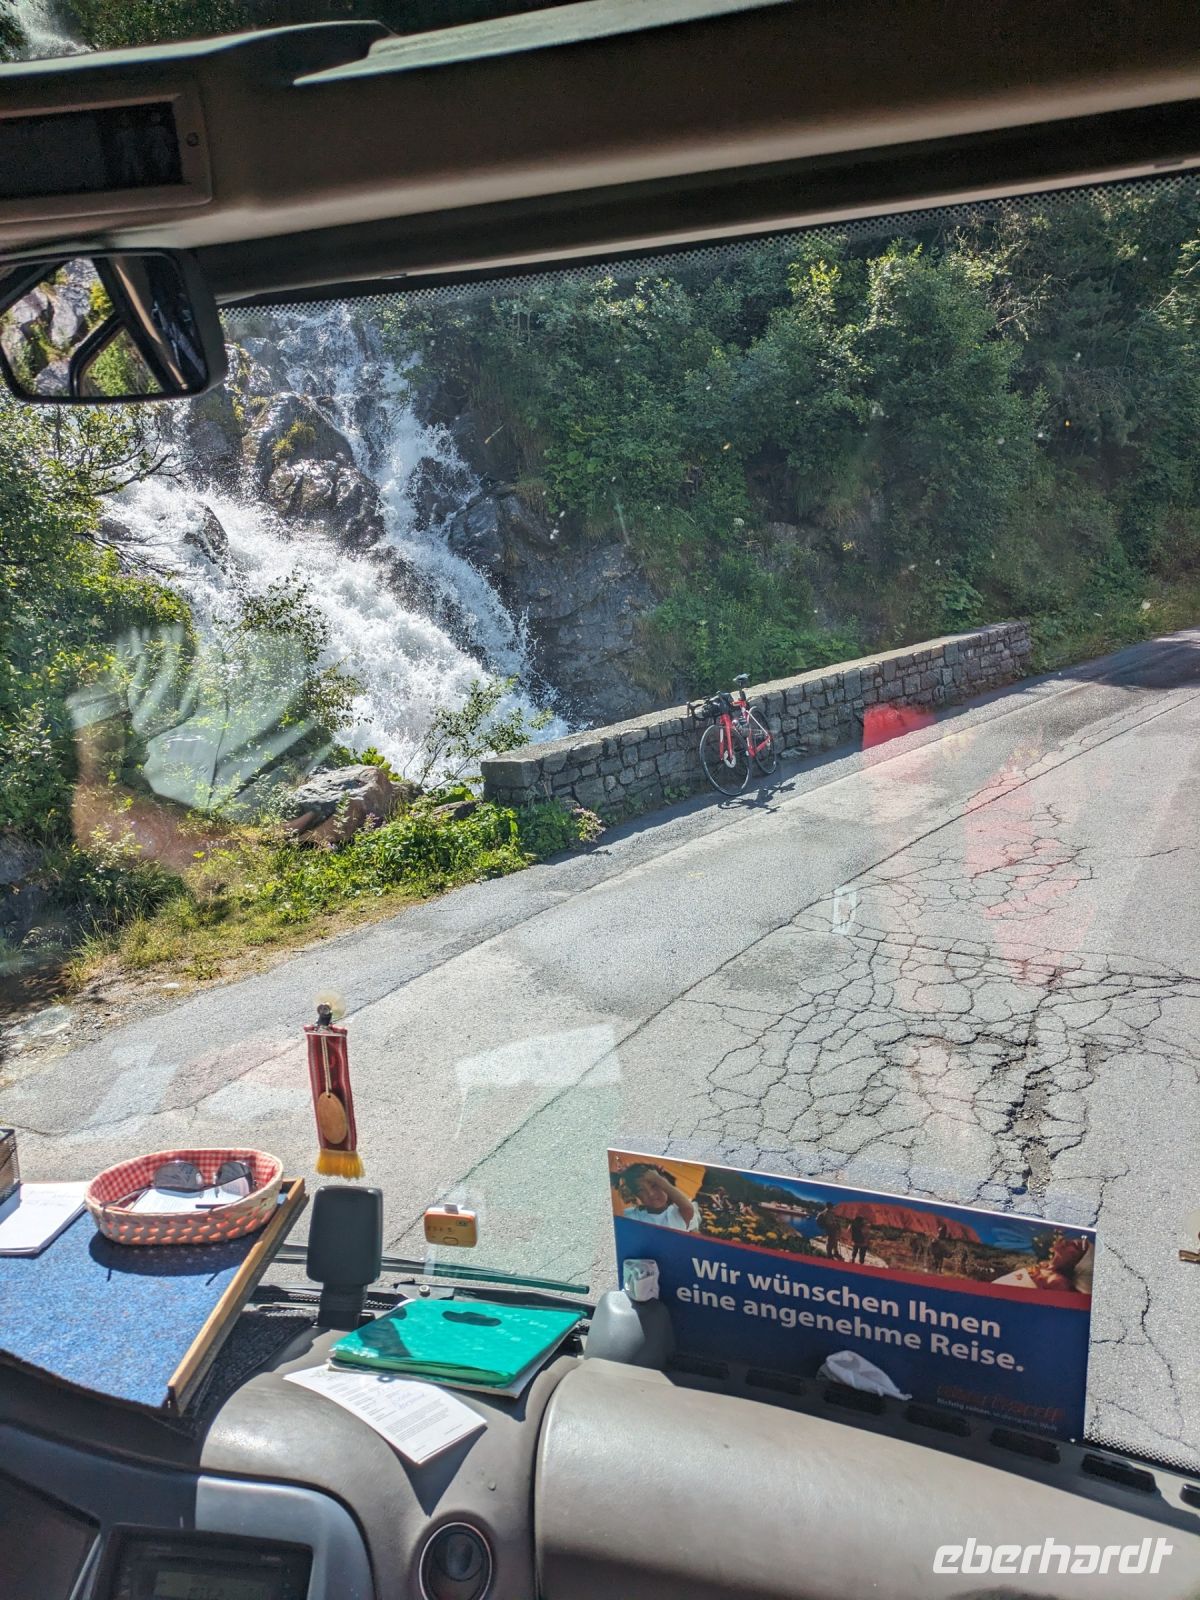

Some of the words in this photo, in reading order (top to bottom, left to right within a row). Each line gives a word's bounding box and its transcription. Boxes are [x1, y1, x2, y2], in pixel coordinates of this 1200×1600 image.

[676, 1284, 736, 1311] eine
[742, 1299, 922, 1350] angenehme
[930, 1332, 1025, 1372] Reise.
[691, 1257, 741, 1285] Wir
[747, 1272, 900, 1318] wünschen
[908, 1300, 1001, 1339] Ihnen
